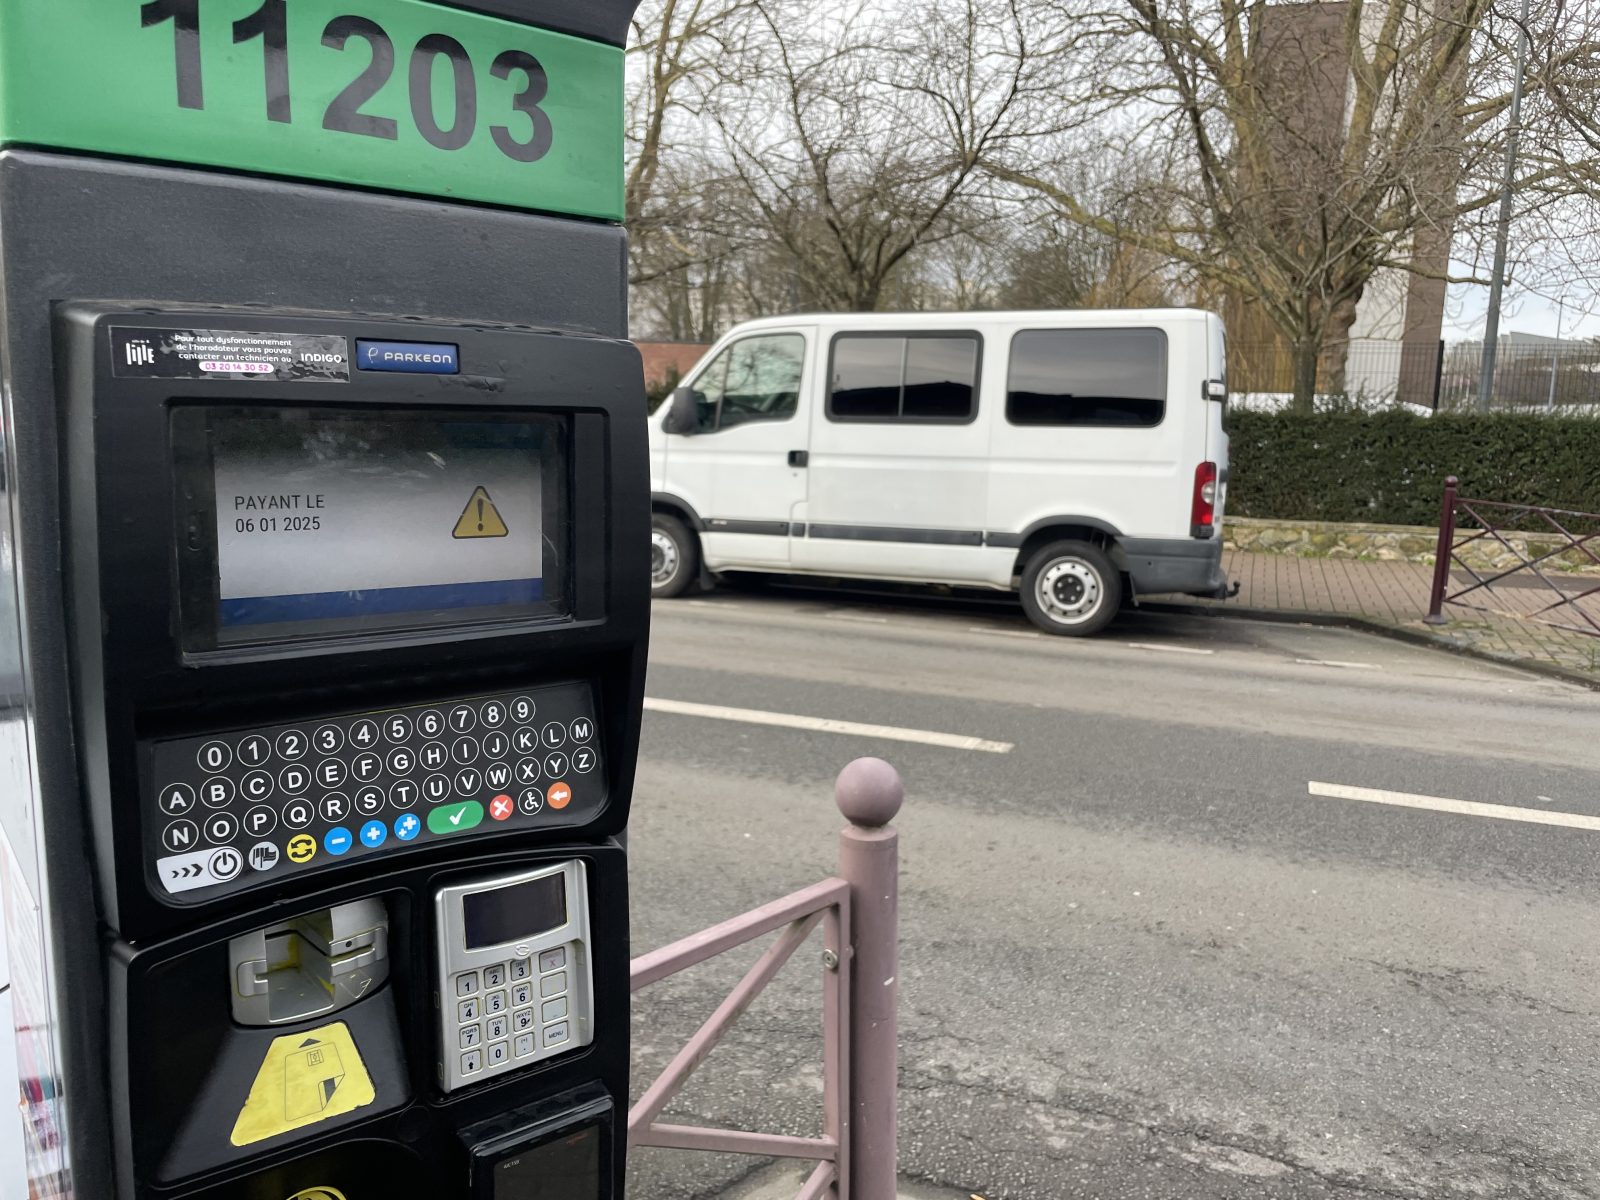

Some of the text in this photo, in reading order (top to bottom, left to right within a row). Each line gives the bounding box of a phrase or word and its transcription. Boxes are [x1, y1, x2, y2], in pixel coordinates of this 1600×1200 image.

[141, 0, 553, 162] 11203
[174, 334, 195, 342] Pour
[216, 336, 292, 346] dysfonctionnement
[189, 344, 240, 352] l'horodateur
[236, 354, 278, 362] technicien
[301, 353, 342, 364] INDIGO
[385, 352, 451, 364] PARKEON
[234, 495, 325, 510] PAYANT LE
[235, 516, 320, 533] 06 01 2025
[207, 701, 529, 767] 0 1 2 3 4 5 6 7 8 9
[169, 791, 187, 809] A
[210, 784, 226, 802] B
[249, 777, 265, 795] C
[287, 771, 303, 789] D
[325, 765, 339, 782] E
[361, 759, 373, 776] F
[393, 754, 409, 770] G
[427, 748, 441, 765] H
[491, 738, 500, 753] J
[519, 732, 532, 748] K
[549, 729, 560, 743] L
[575, 723, 588, 739] M
[172, 753, 589, 846] N O P Q R S T U V W X Y Z
[464, 967, 525, 992] 1 2 3
[465, 992, 526, 1018] 4 5 6
[516, 1010, 531, 1019] WXYZ
[466, 1018, 527, 1044] 7 8 9
[549, 1030, 564, 1038] MENU
[495, 1048, 502, 1058] 0
